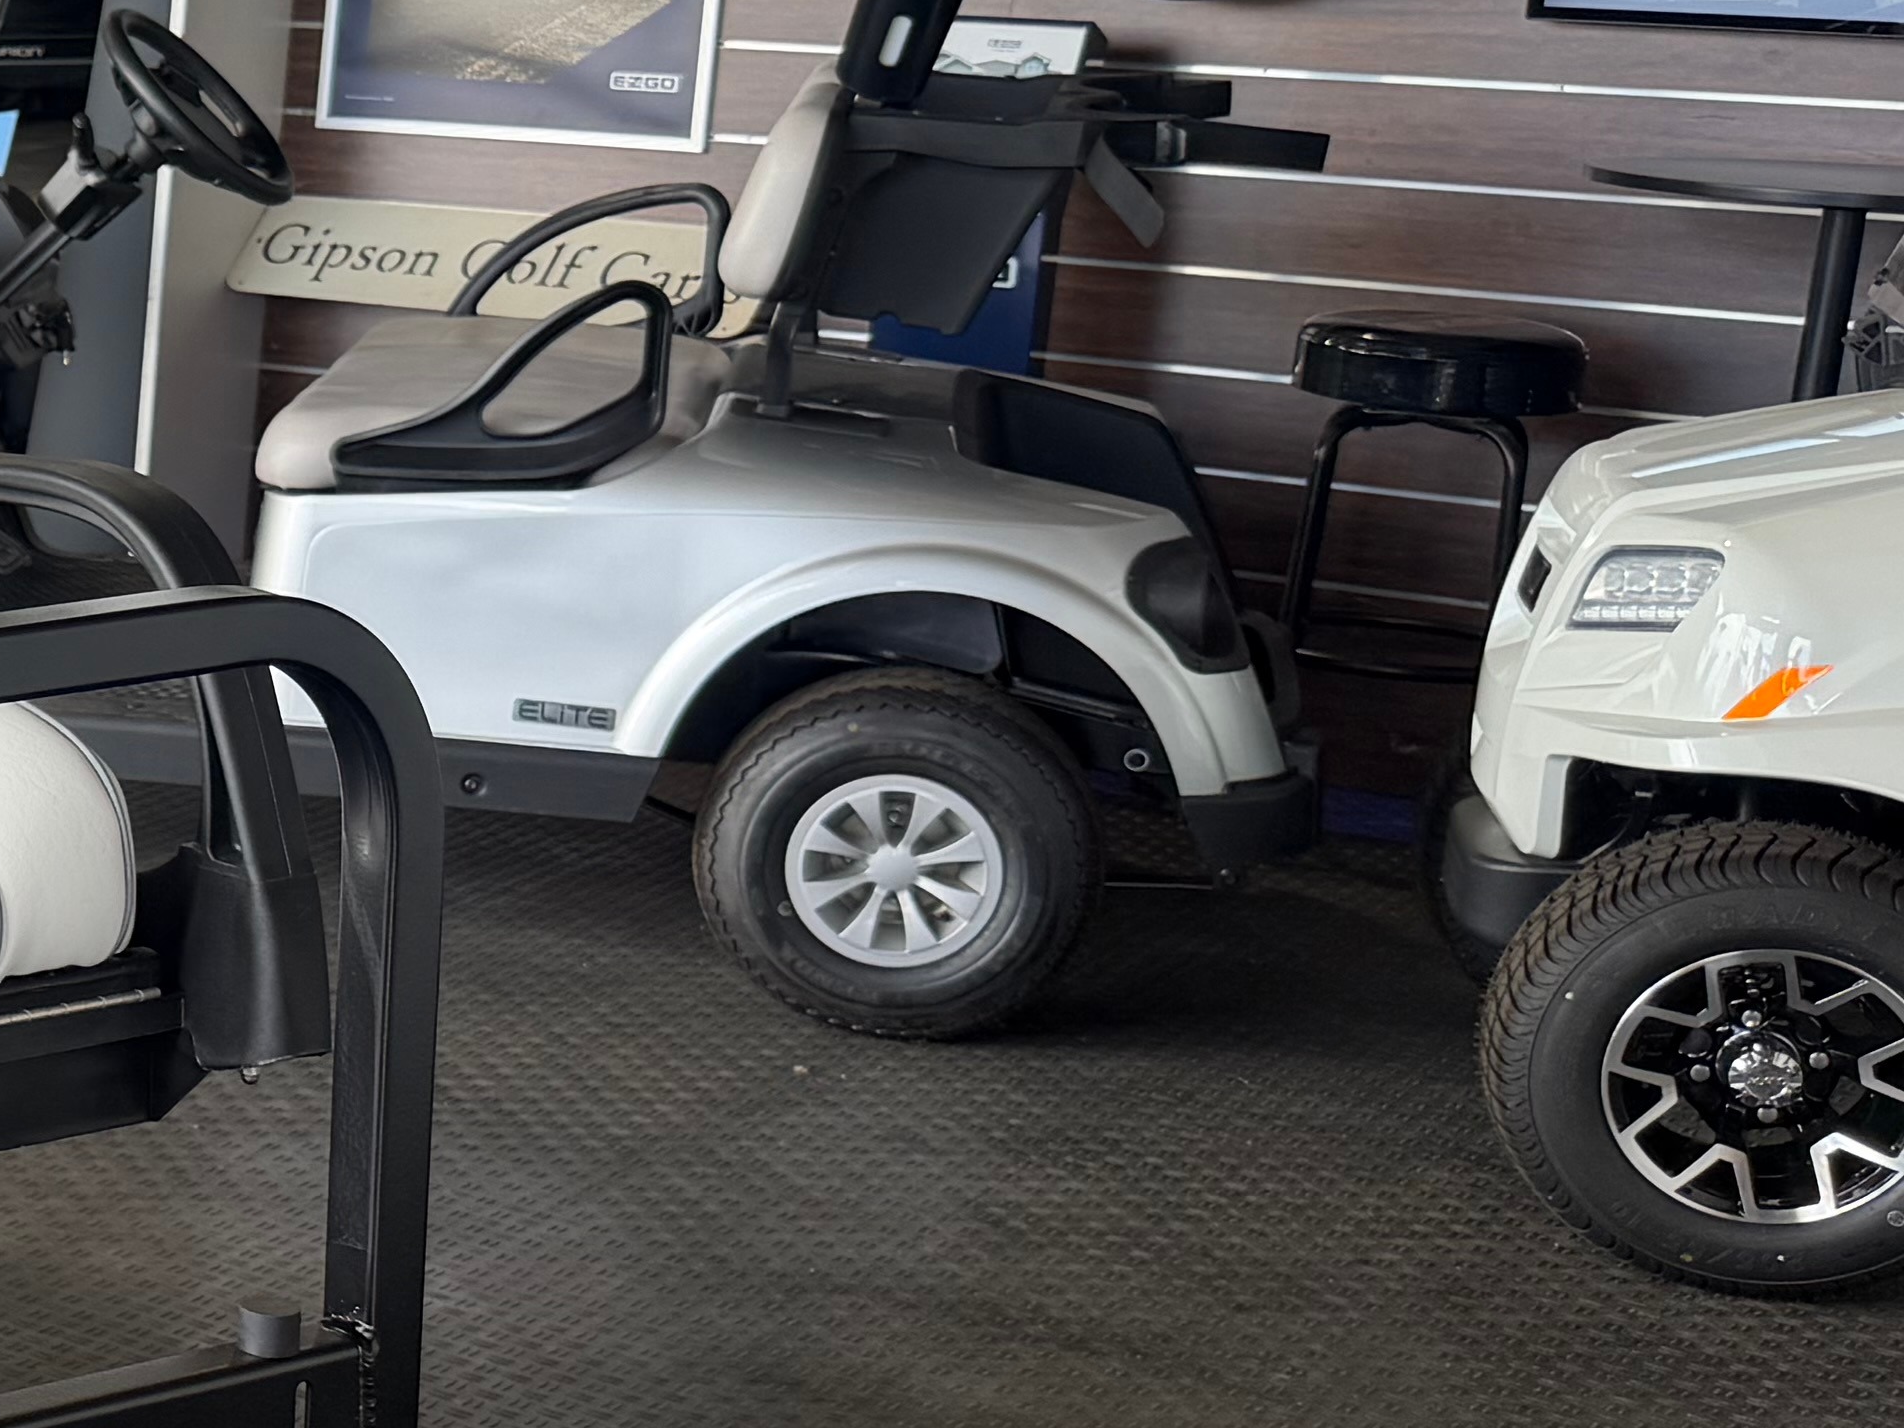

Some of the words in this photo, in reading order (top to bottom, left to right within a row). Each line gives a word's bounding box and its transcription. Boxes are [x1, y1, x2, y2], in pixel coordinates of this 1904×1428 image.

[613, 75, 676, 90] EZGO
[261, 223, 439, 283] Gipson
[461, 239, 598, 290] Golf
[600, 251, 741, 305] Car
